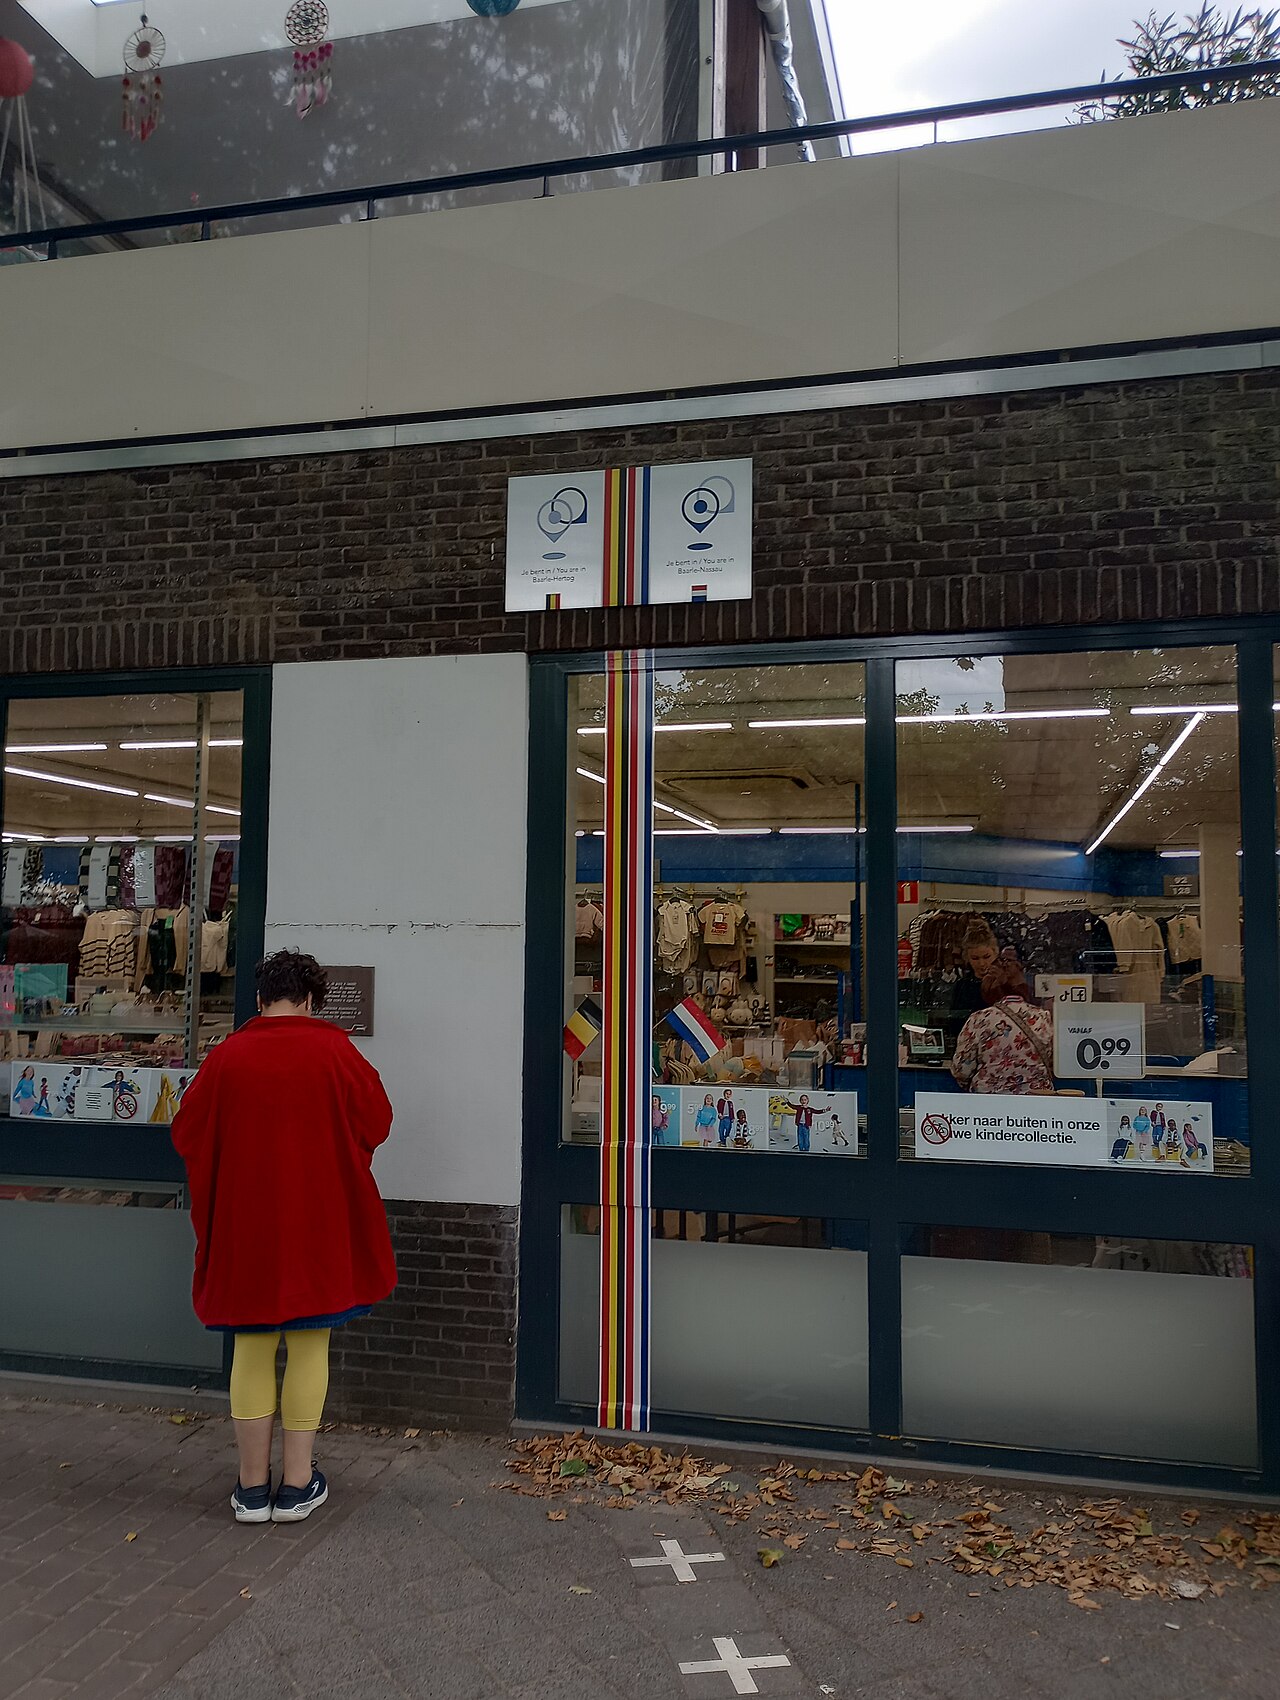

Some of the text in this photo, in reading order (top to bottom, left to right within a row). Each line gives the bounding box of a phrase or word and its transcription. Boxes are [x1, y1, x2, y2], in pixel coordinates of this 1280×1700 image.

[677, 566, 723, 574] Baarle-Nassau
[1076, 1038, 1131, 1070] 0.99
[973, 1116, 1002, 1127] naar
[1006, 1115, 1048, 1129] buiten
[1051, 1117, 1063, 1130] in
[1067, 1119, 1100, 1131] onze
[975, 1129, 1077, 1144] kindercollectie.
